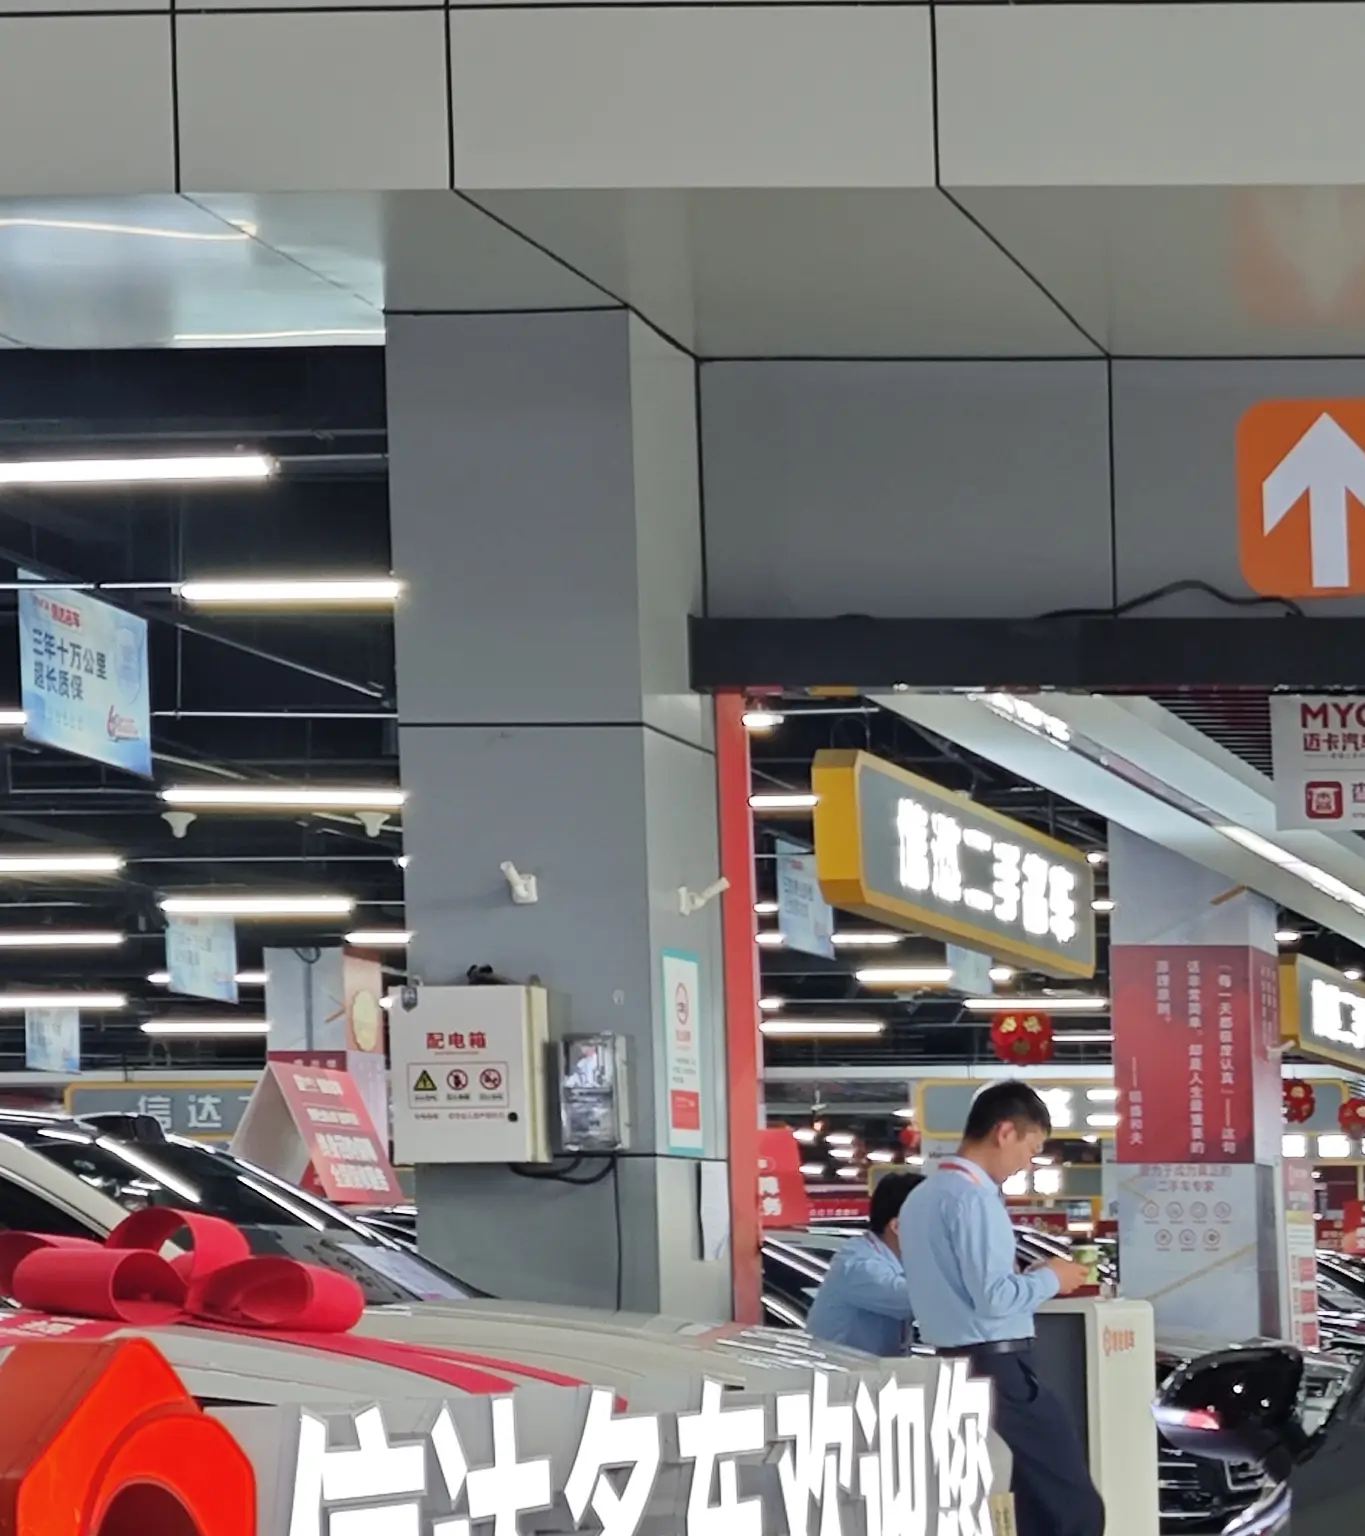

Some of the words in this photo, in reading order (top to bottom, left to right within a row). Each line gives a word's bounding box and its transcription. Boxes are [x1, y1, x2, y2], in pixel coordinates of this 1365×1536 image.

[426, 1032, 487, 1049] 配电箱
[138, 1095, 250, 1129] 信达
